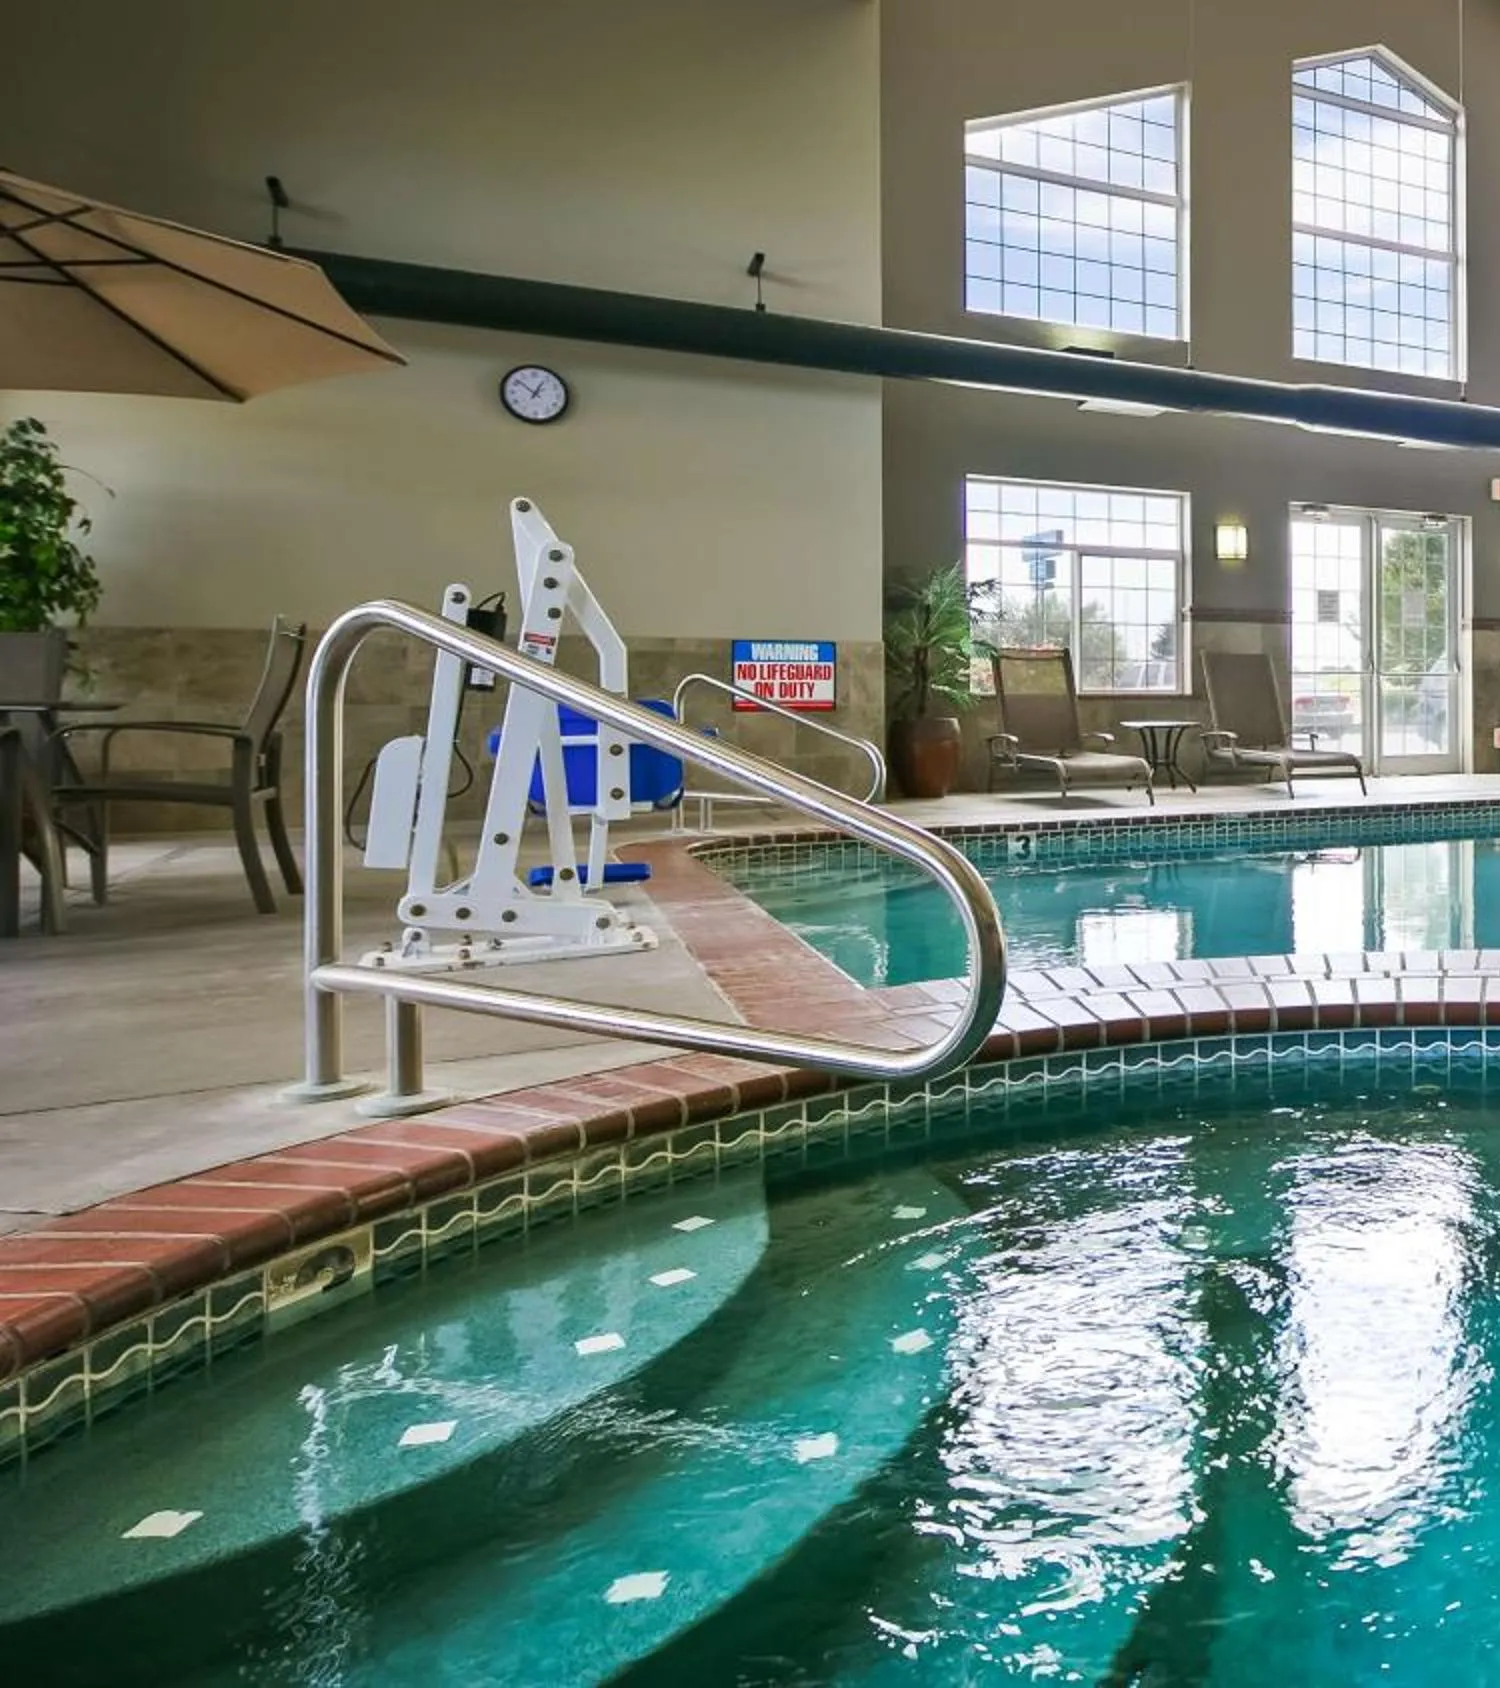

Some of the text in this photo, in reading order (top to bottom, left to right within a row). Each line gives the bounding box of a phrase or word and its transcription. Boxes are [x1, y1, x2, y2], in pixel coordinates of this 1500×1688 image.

[751, 643, 818, 660] WARNING
[737, 664, 831, 680] NO LIFEGUARD
[754, 682, 815, 698] ON DUTY
[1015, 835, 1030, 860] 3
